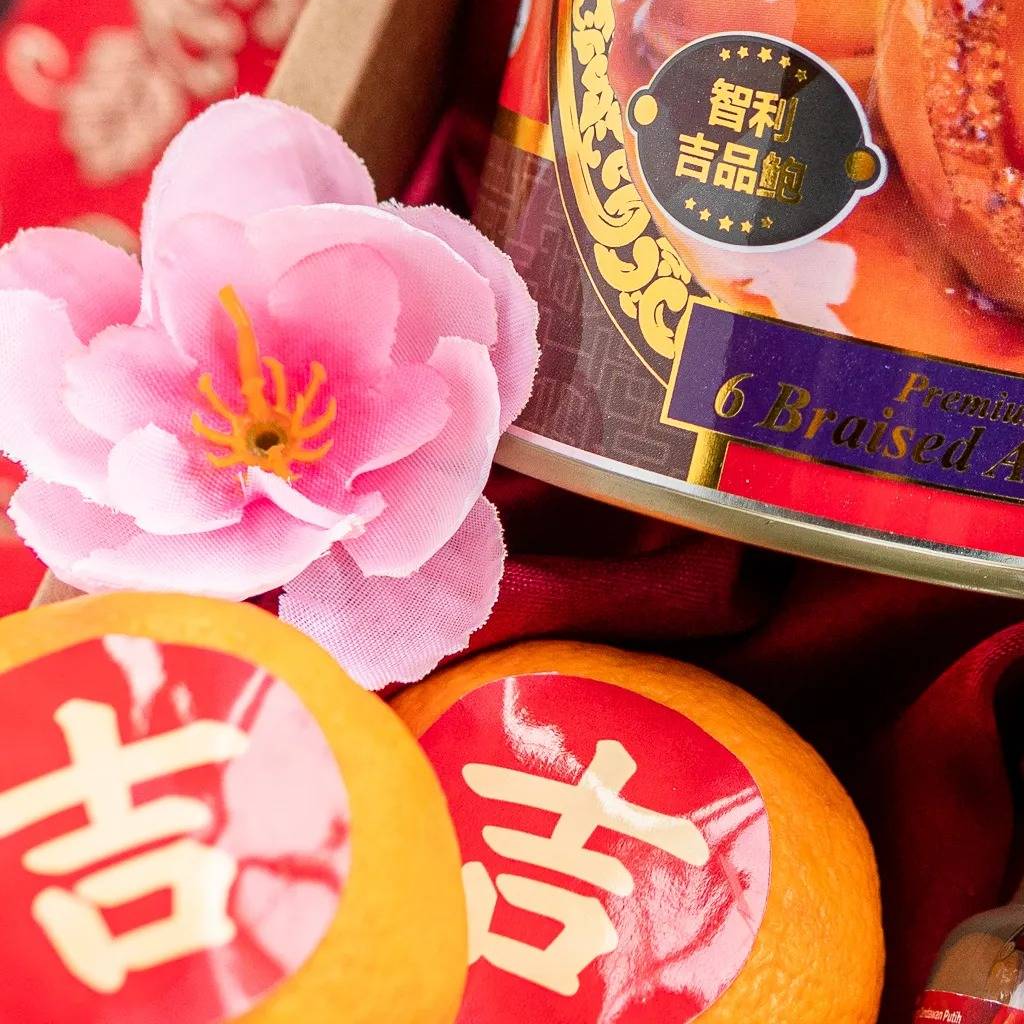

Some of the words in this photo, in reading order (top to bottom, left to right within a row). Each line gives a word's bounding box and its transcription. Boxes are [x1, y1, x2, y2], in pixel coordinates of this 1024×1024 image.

[708, 77, 799, 143] 智利
[713, 372, 754, 419] 6
[753, 382, 986, 472] Braised
[0, 698, 251, 994] 吉
[464, 739, 711, 997] 吉
